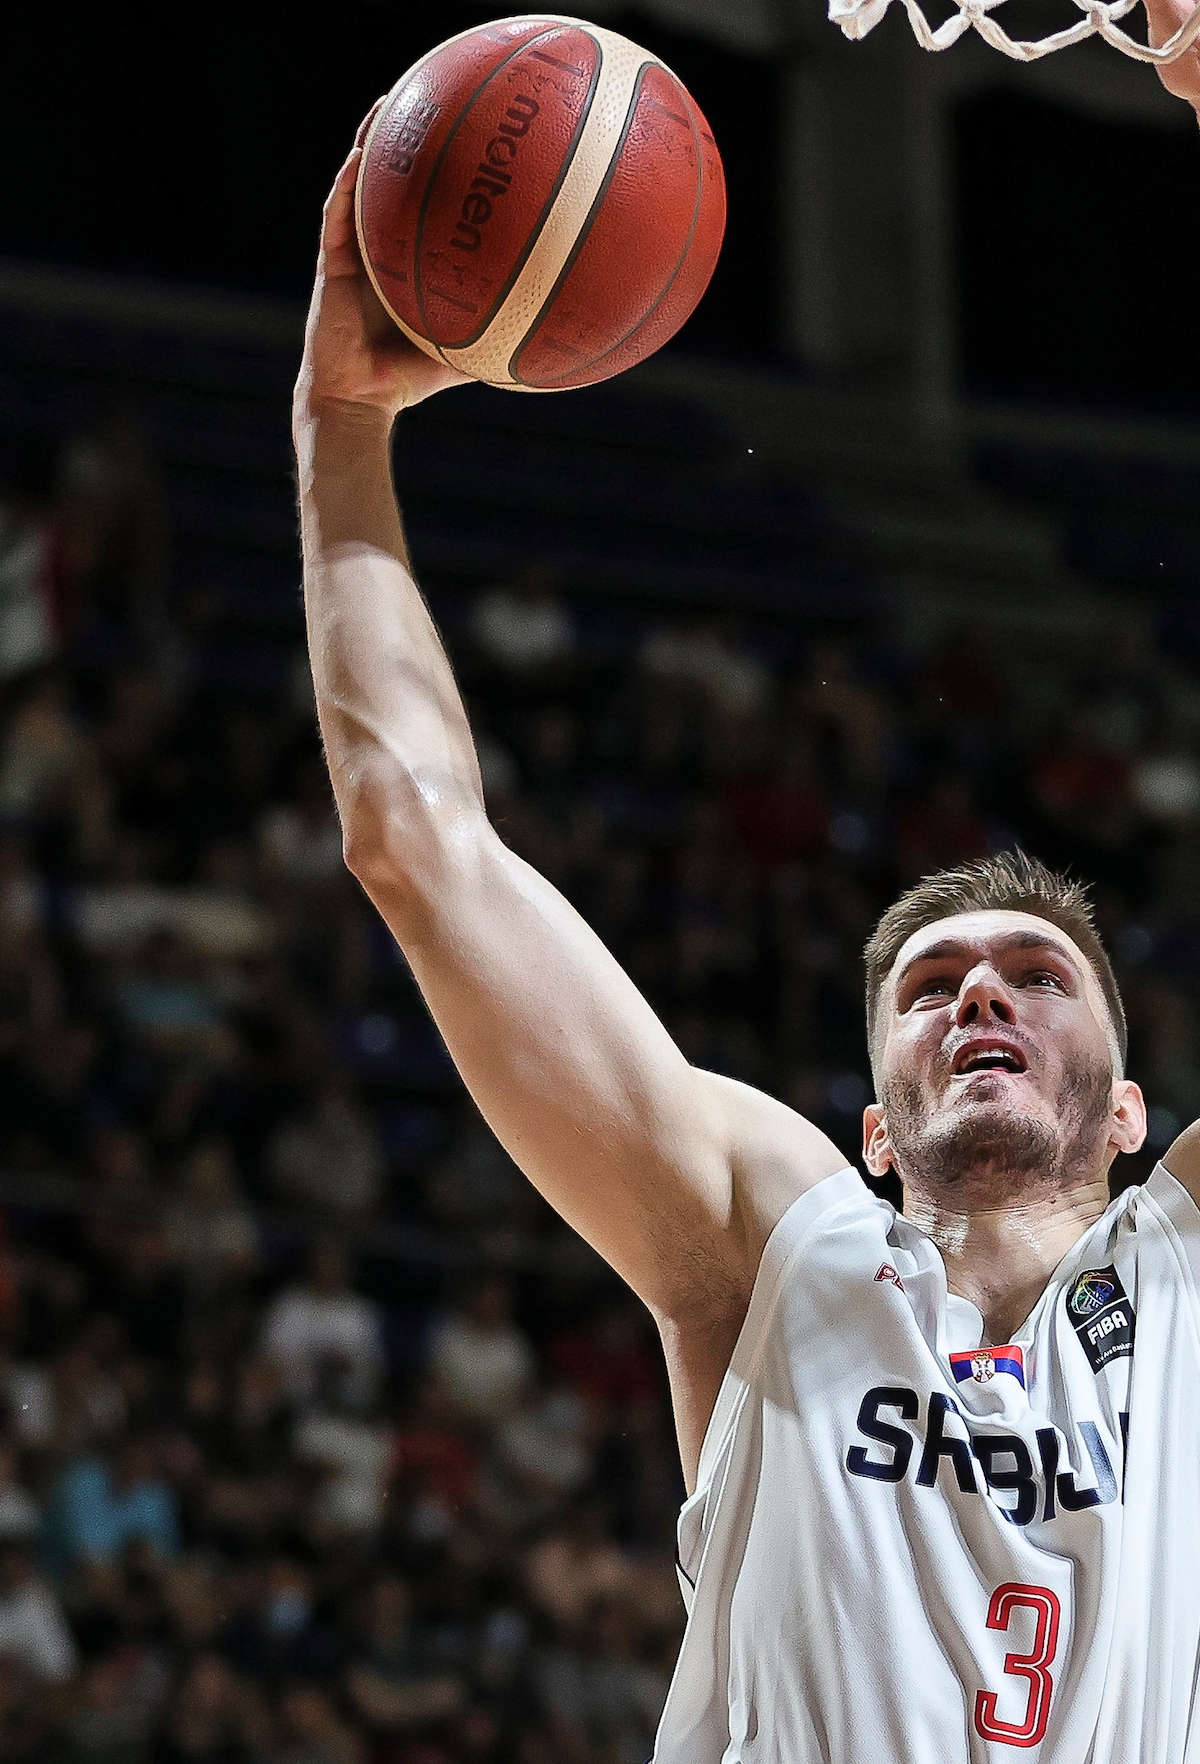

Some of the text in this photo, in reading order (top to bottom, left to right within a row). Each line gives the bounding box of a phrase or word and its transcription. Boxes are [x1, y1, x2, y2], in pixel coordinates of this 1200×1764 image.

[451, 94, 540, 251] molten
[1087, 1310, 1128, 1346] FIBA
[846, 1386, 1129, 1527] SRBIJ
[974, 1581, 1061, 1748] 3
